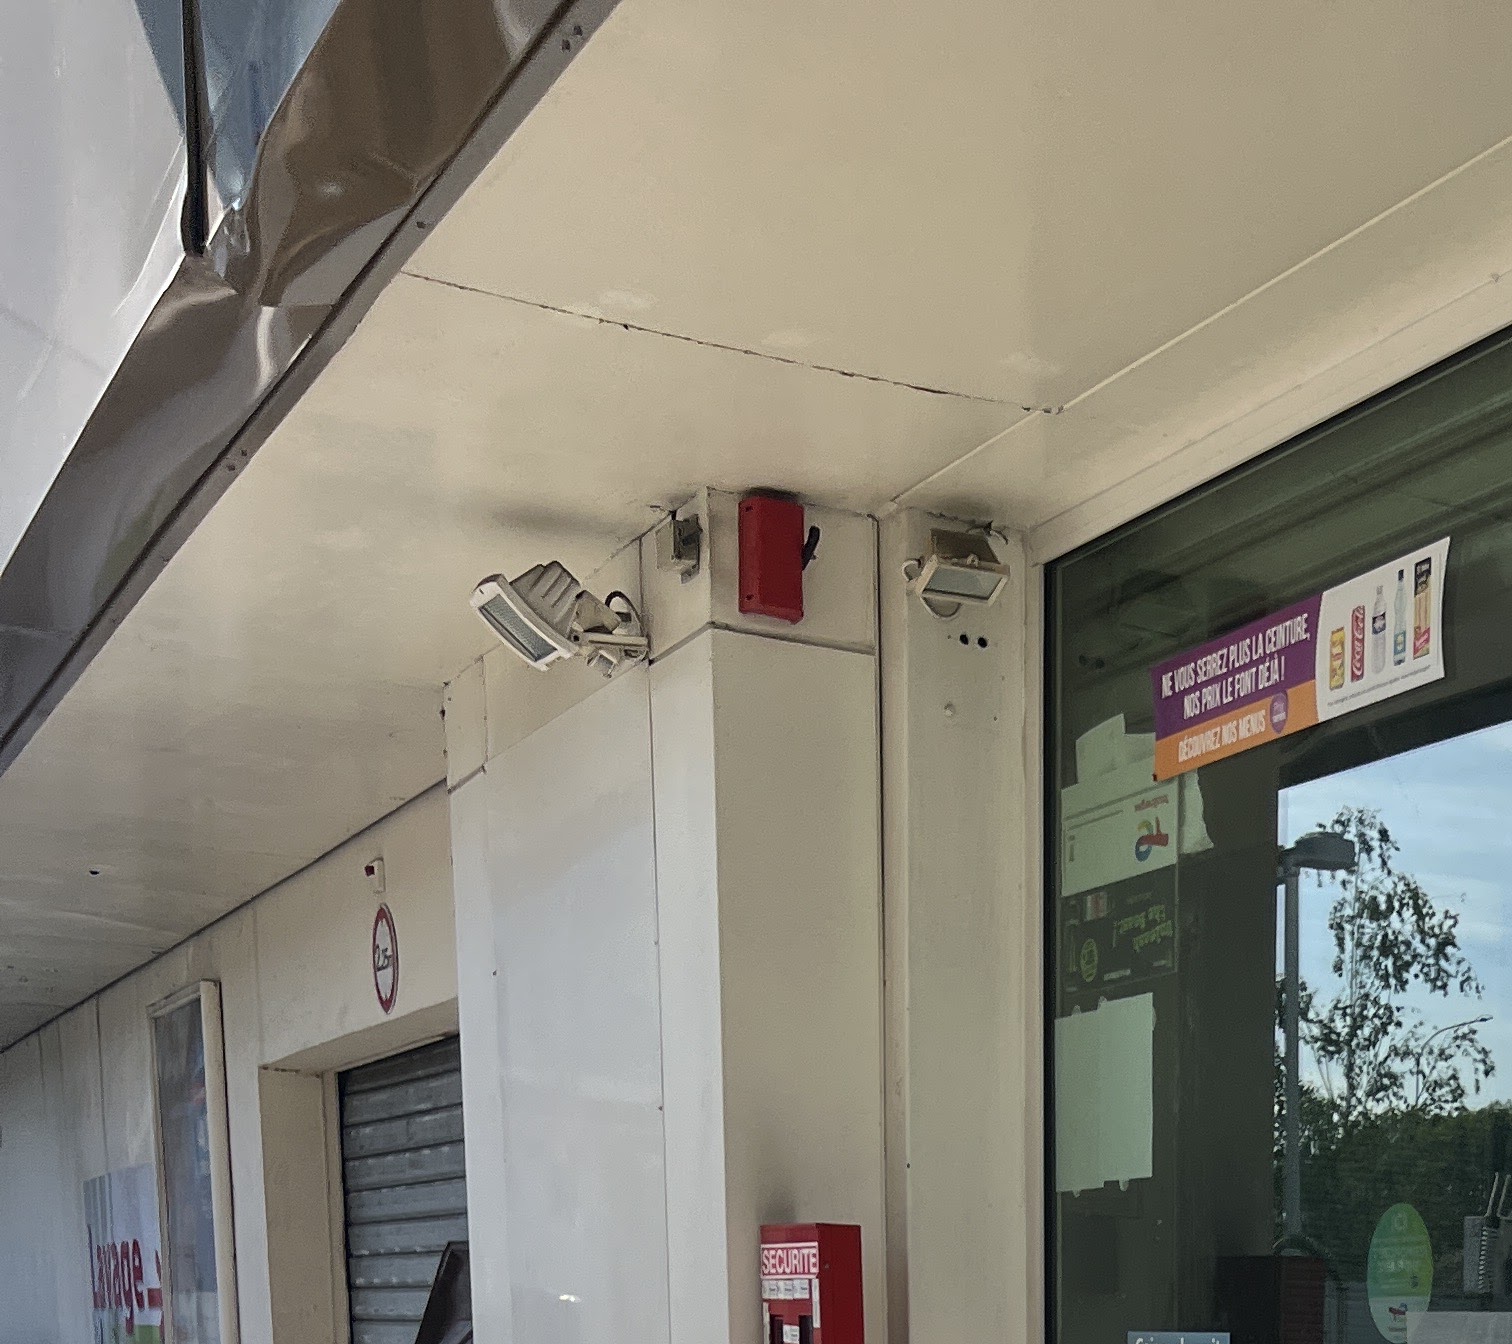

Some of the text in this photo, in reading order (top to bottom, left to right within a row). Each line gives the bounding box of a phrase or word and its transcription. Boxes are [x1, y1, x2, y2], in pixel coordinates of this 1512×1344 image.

[1162, 613, 1311, 698] NE VOUS SERREZ PLUS LA CEINTURE,
[1183, 690, 1200, 720] NOS
[1201, 682, 1221, 713] PRIX
[1222, 677, 1234, 704] LE
[1235, 668, 1257, 699] FONT
[1258, 653, 1279, 690] DÉJÀ
[1178, 726, 1221, 763] DÉCOUVREZ
[1222, 720, 1237, 746] NOS
[1239, 710, 1266, 740] MENUS
[762, 1248, 818, 1274] SECURITE
